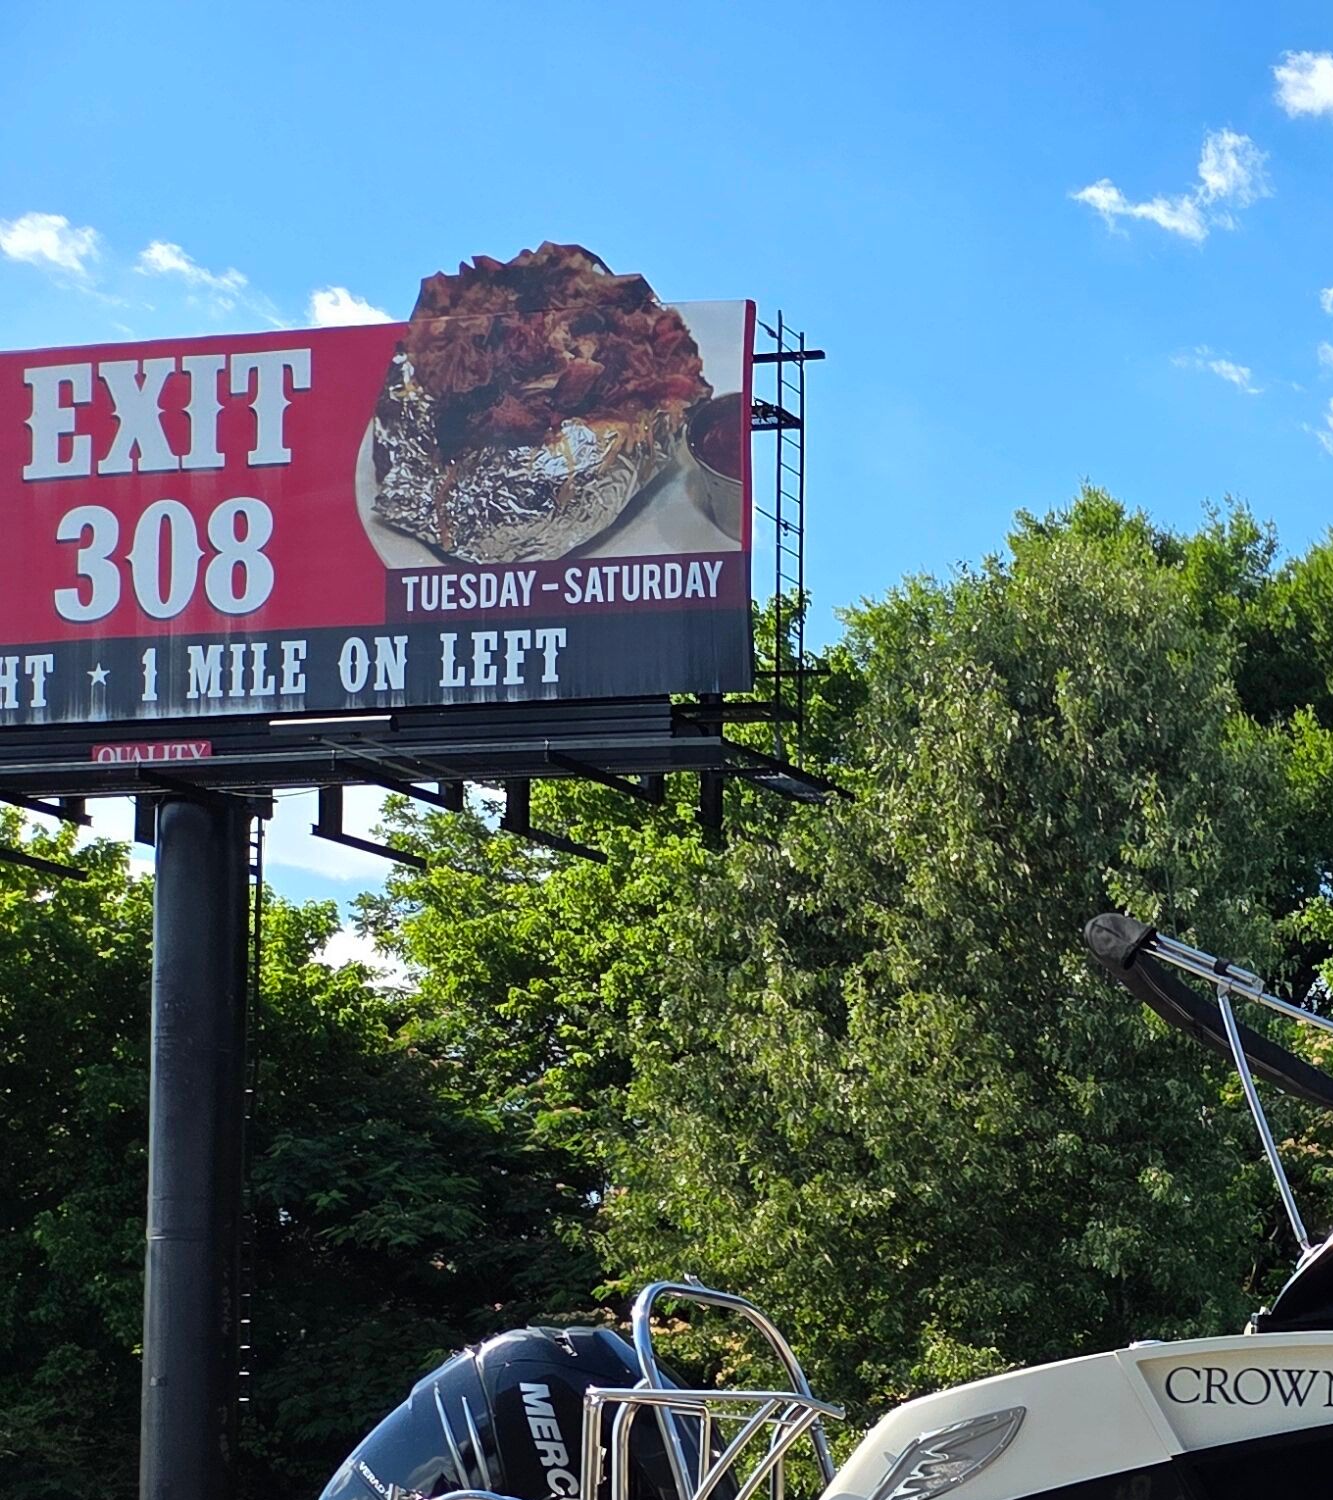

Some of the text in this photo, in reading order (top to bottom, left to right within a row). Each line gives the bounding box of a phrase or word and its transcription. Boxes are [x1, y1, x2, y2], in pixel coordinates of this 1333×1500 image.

[23, 348, 311, 481] EXIT
[54, 497, 275, 621] 308
[141, 648, 158, 701] 1
[187, 640, 307, 699] MILE
[338, 635, 408, 693] ON
[439, 627, 567, 688] LEFT
[97, 743, 206, 763] QUALITY
